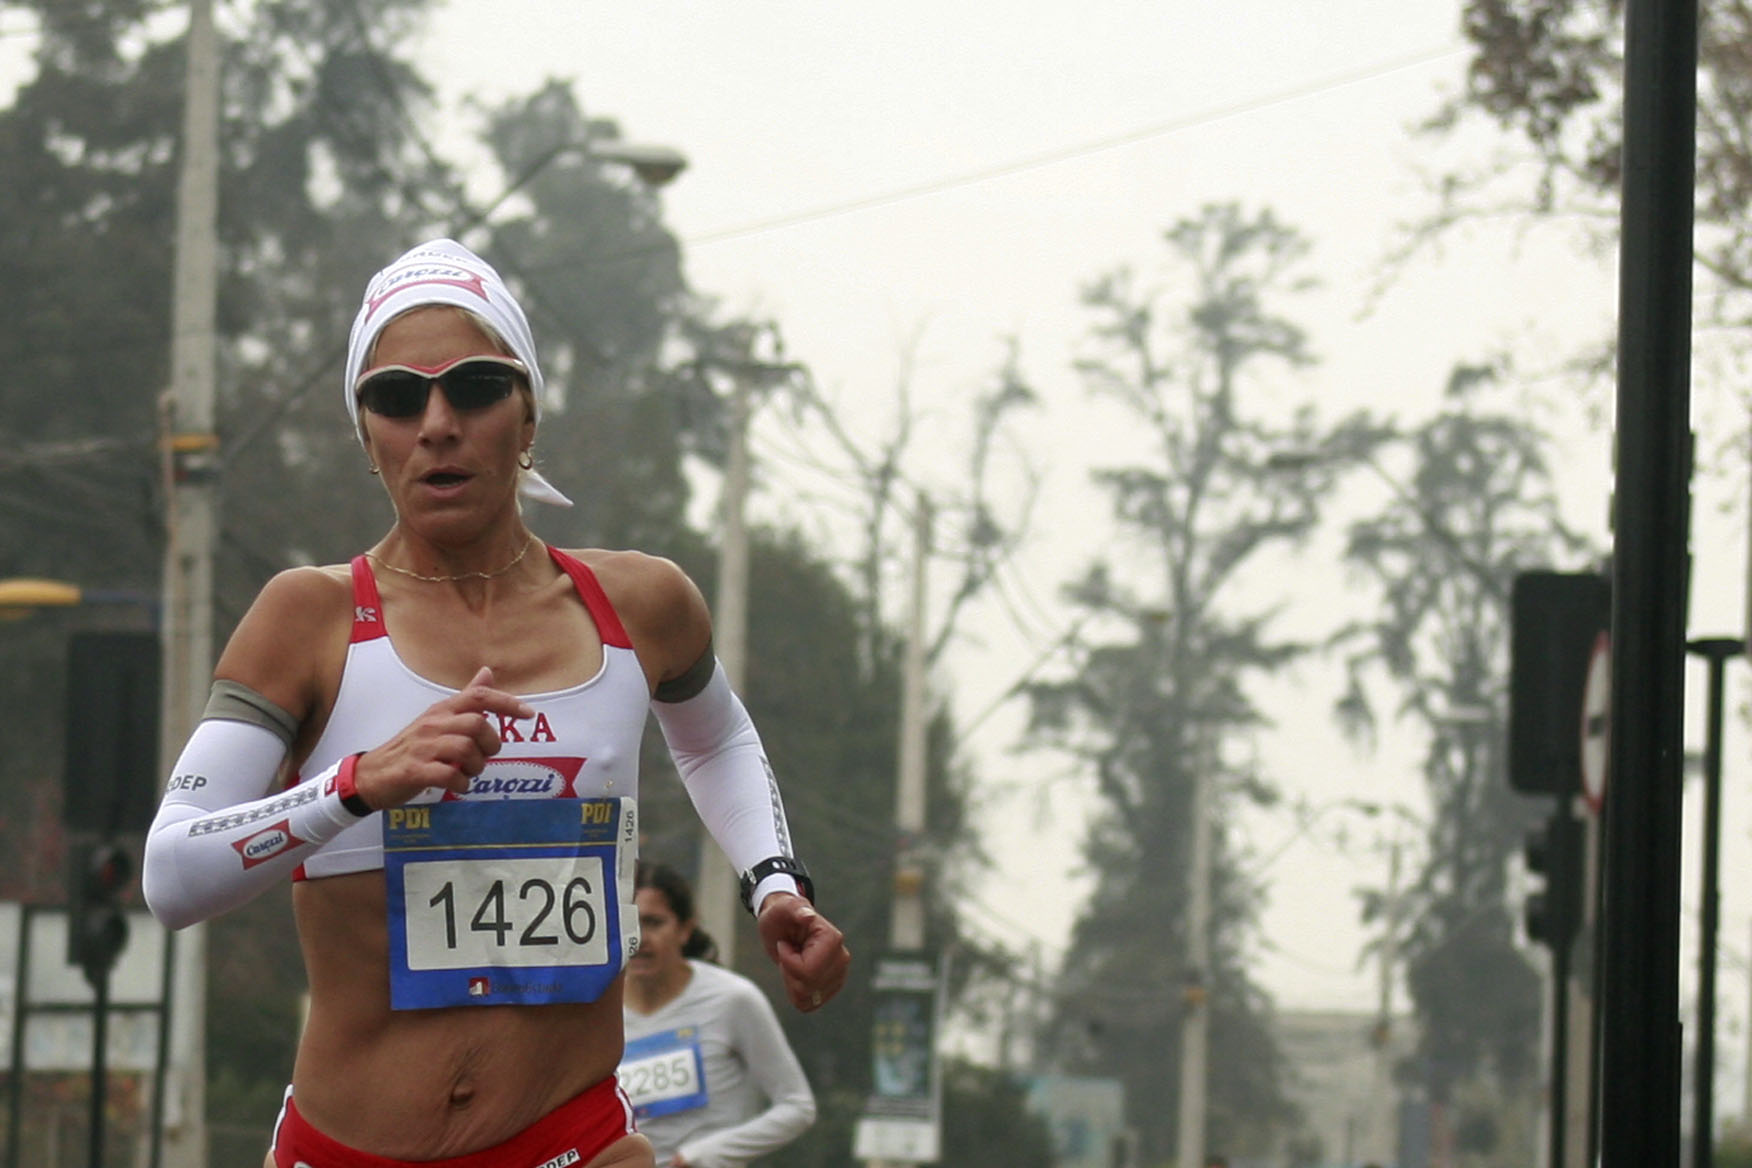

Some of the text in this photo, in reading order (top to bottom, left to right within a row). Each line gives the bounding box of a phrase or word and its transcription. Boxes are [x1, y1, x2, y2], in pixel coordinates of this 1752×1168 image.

[389, 808, 430, 830] PDI
[581, 803, 612, 824] PDI
[624, 811, 635, 842] 1426
[429, 877, 596, 949] 1426
